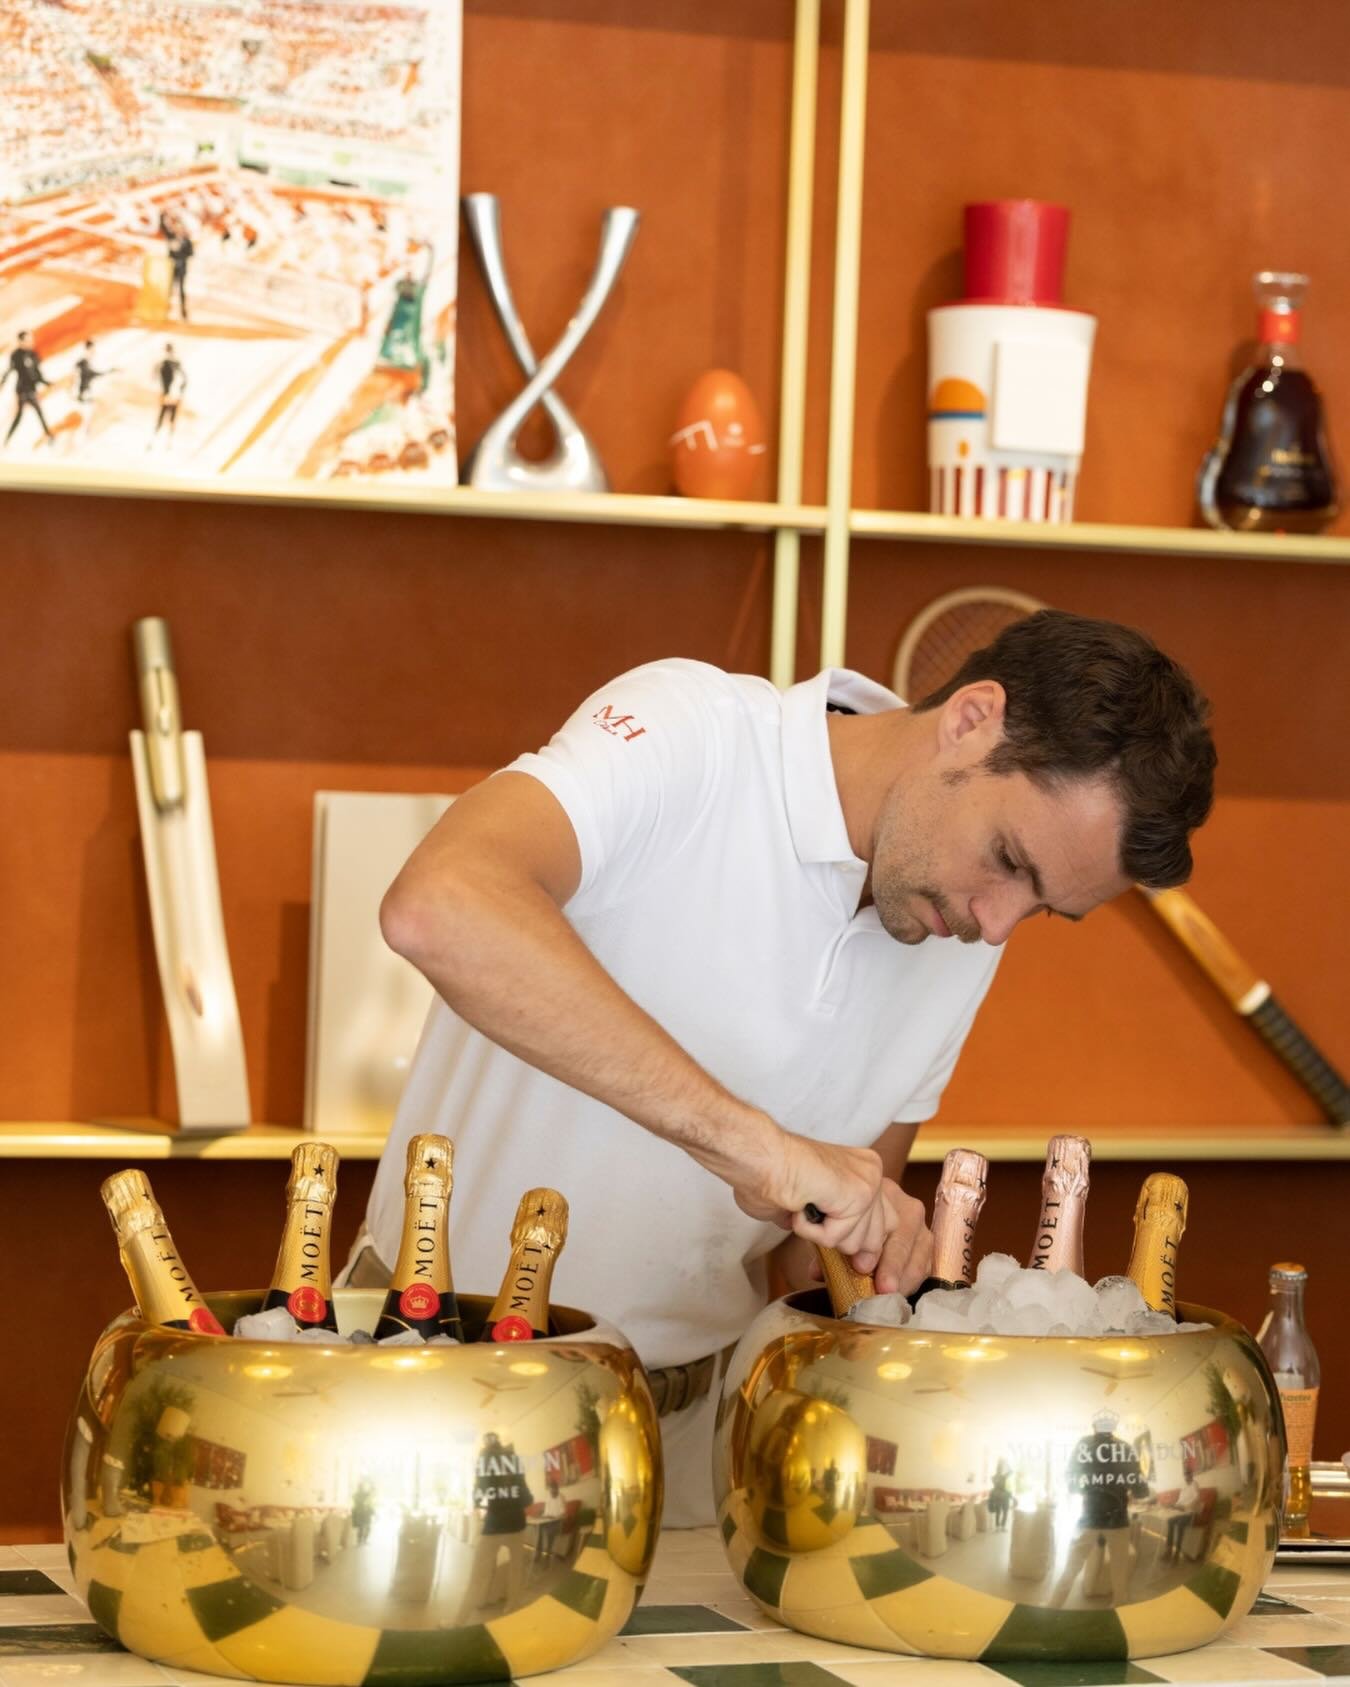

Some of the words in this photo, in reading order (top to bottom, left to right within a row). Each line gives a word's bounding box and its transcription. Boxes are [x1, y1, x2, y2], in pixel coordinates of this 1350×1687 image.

[593, 705, 646, 741] MH
[300, 1204, 324, 1282] MOËT
[414, 1198, 437, 1278] MOËT
[510, 1243, 542, 1312] MOËT
